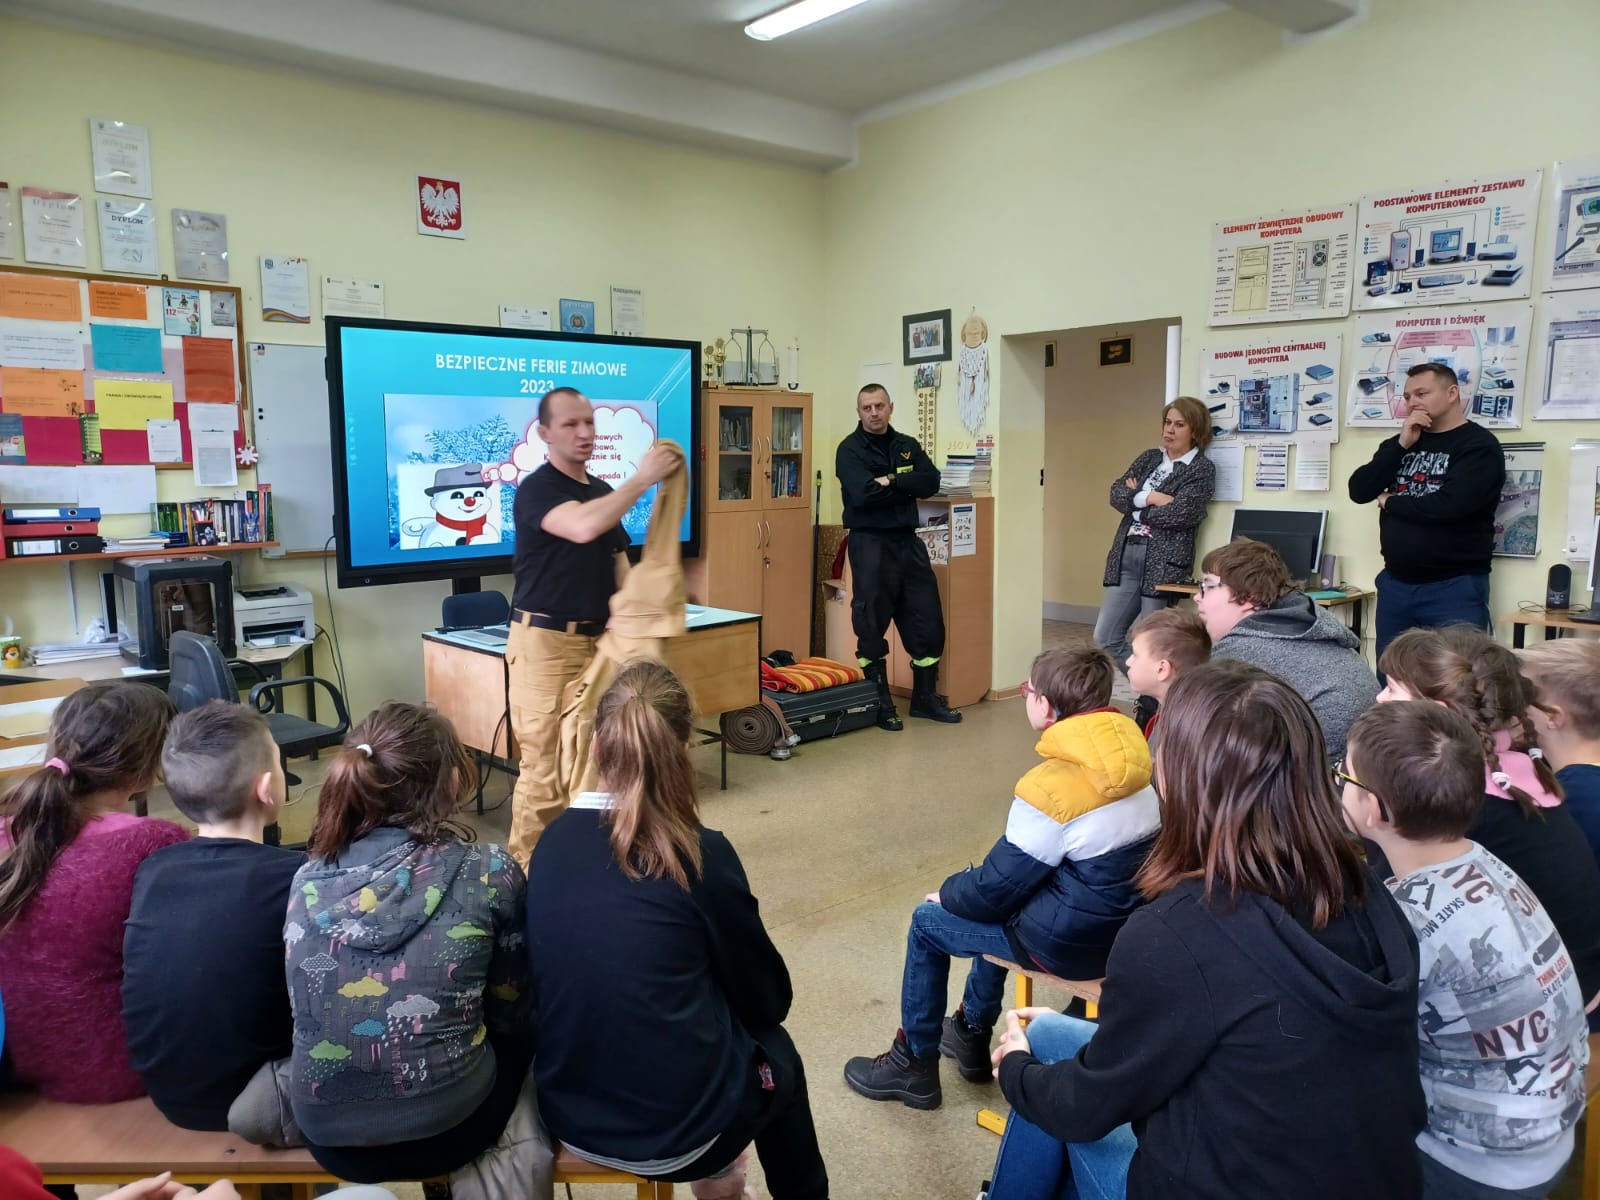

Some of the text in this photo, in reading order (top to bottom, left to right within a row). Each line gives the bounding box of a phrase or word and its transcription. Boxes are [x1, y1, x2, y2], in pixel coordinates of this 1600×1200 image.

[1373, 178, 1525, 208] PODSTAWOWE ELEMENTY ZESTAWU
[1406, 196, 1486, 214] KOMPUTEROWEGO
[111, 215, 143, 224] DYPLOM
[1223, 210, 1344, 234] ELEMENTY ZEWNĘTRZNE OBUDOWY
[1260, 226, 1302, 238] KOMPUTERA
[166, 308, 177, 316] 112
[1396, 317, 1441, 327] KOMPUTER
[1215, 341, 1326, 359] BUDOWA JEDNOSTKI CENTRALNEJ
[435, 353, 627, 376] BEZPIECZNE FERIE ZIMOWE
[1248, 355, 1289, 365] KOMPUTERA
[520, 378, 555, 394] 2023
[610, 453, 621, 461] się
[1435, 897, 1465, 923] SKATE
[1542, 976, 1562, 999] SKATE
[1472, 1009, 1549, 1058] NYC
